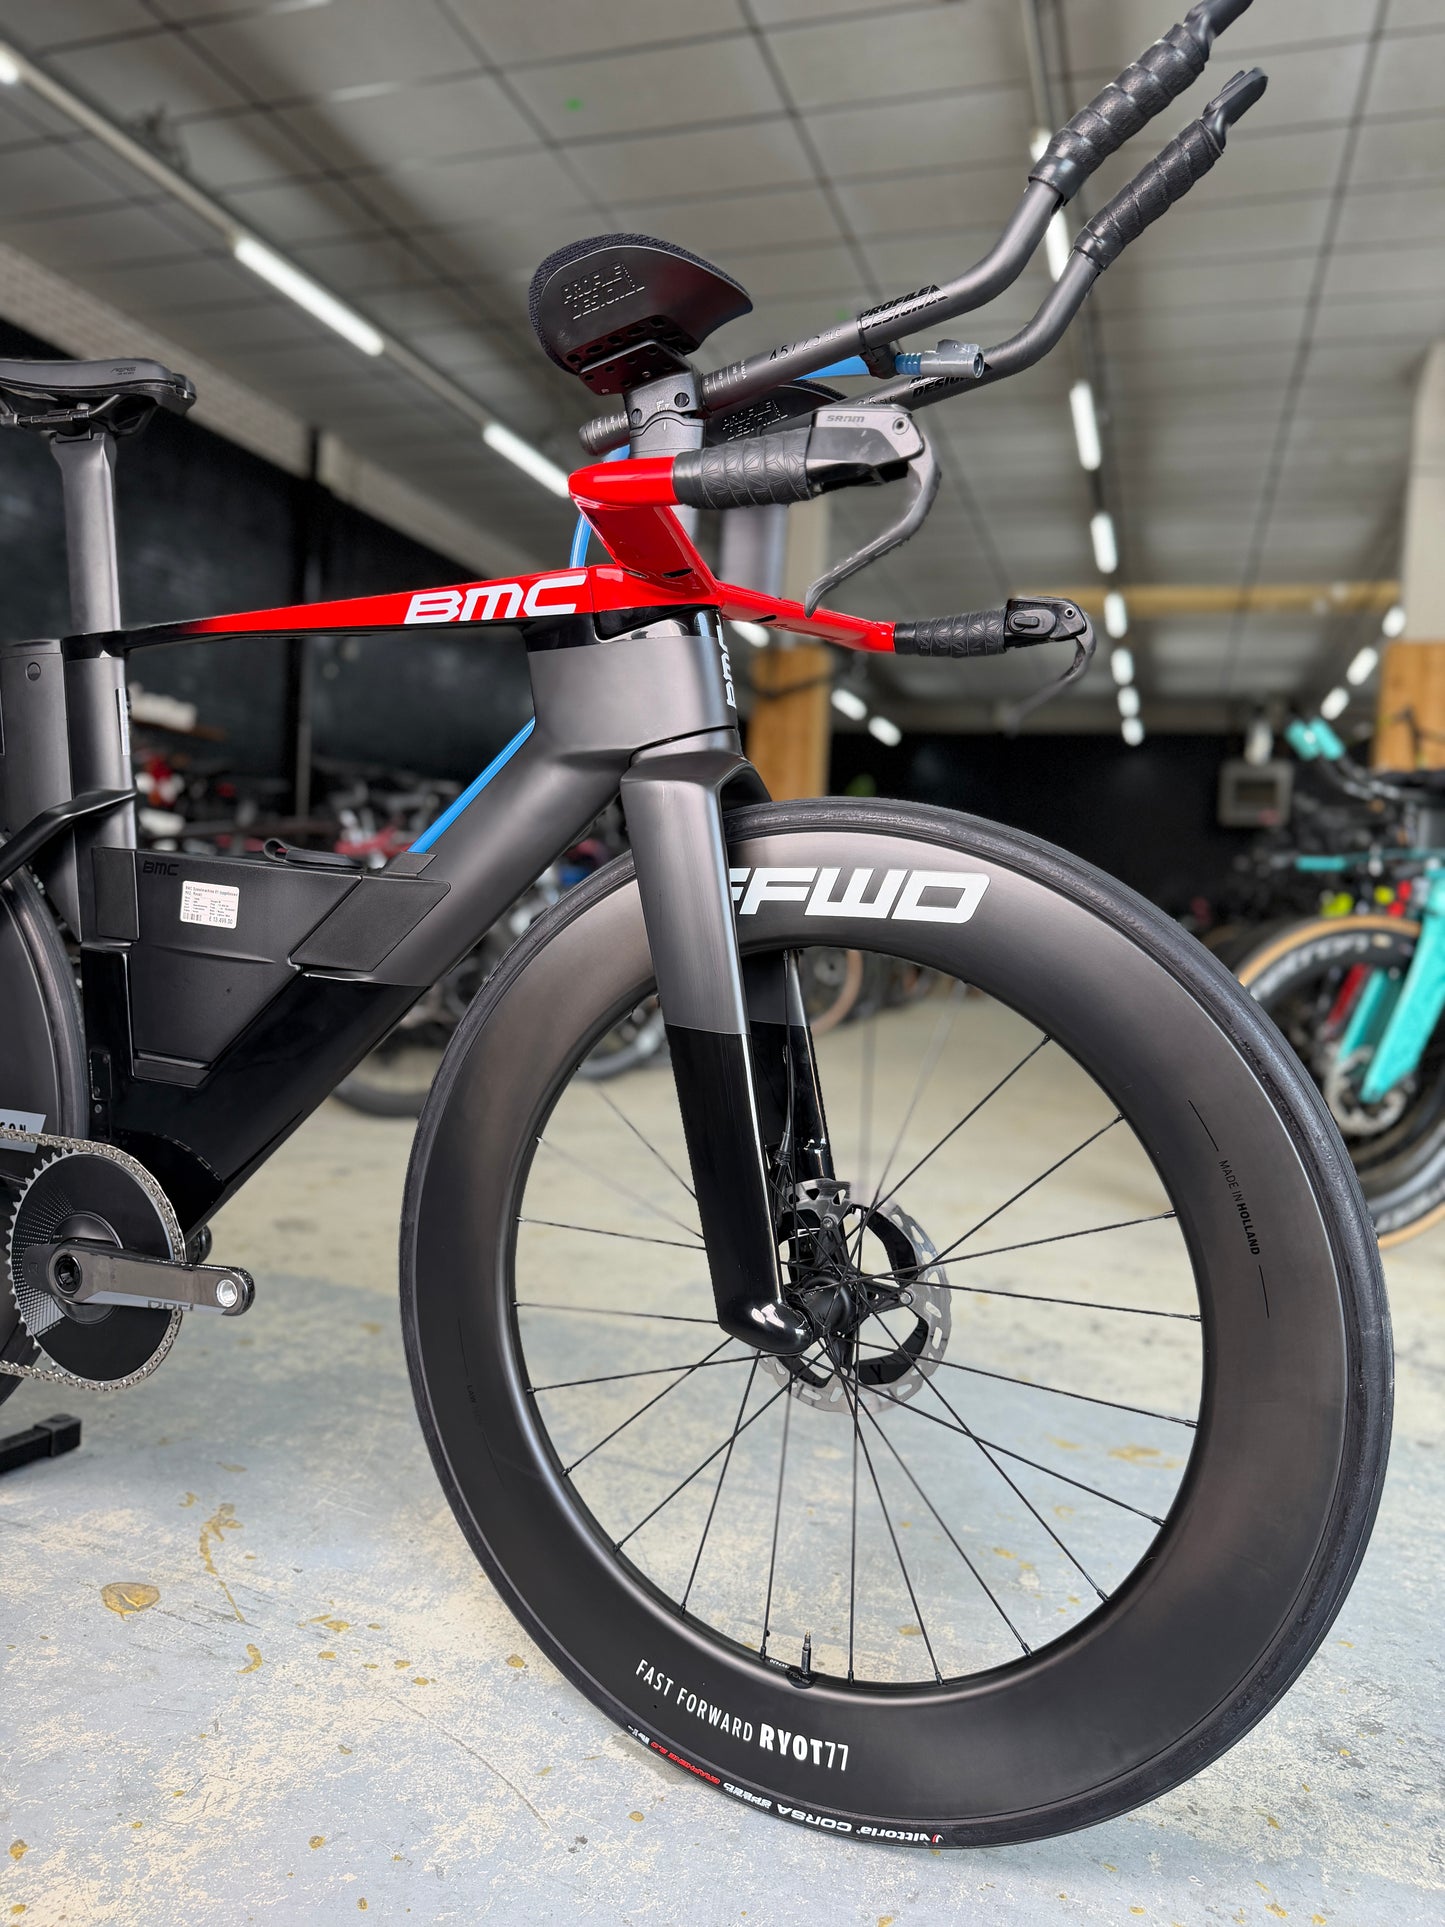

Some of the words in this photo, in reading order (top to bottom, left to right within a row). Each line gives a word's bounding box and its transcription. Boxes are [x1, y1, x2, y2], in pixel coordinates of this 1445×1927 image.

[860, 285, 931, 319] PROFILE
[827, 414, 866, 423] SRAM
[404, 574, 587, 625] BMC
[143, 860, 180, 876] BMC
[729, 867, 991, 924] FWD
[1219, 1160, 1240, 1190] MADE
[1232, 1190, 1244, 1202] IN
[1237, 1203, 1260, 1255] HOLLAND
[635, 1659, 674, 1697] FAST
[676, 1687, 753, 1742] FORWARD
[760, 1723, 849, 1771] RYOT77
[777, 1803, 852, 1832] CORSA
